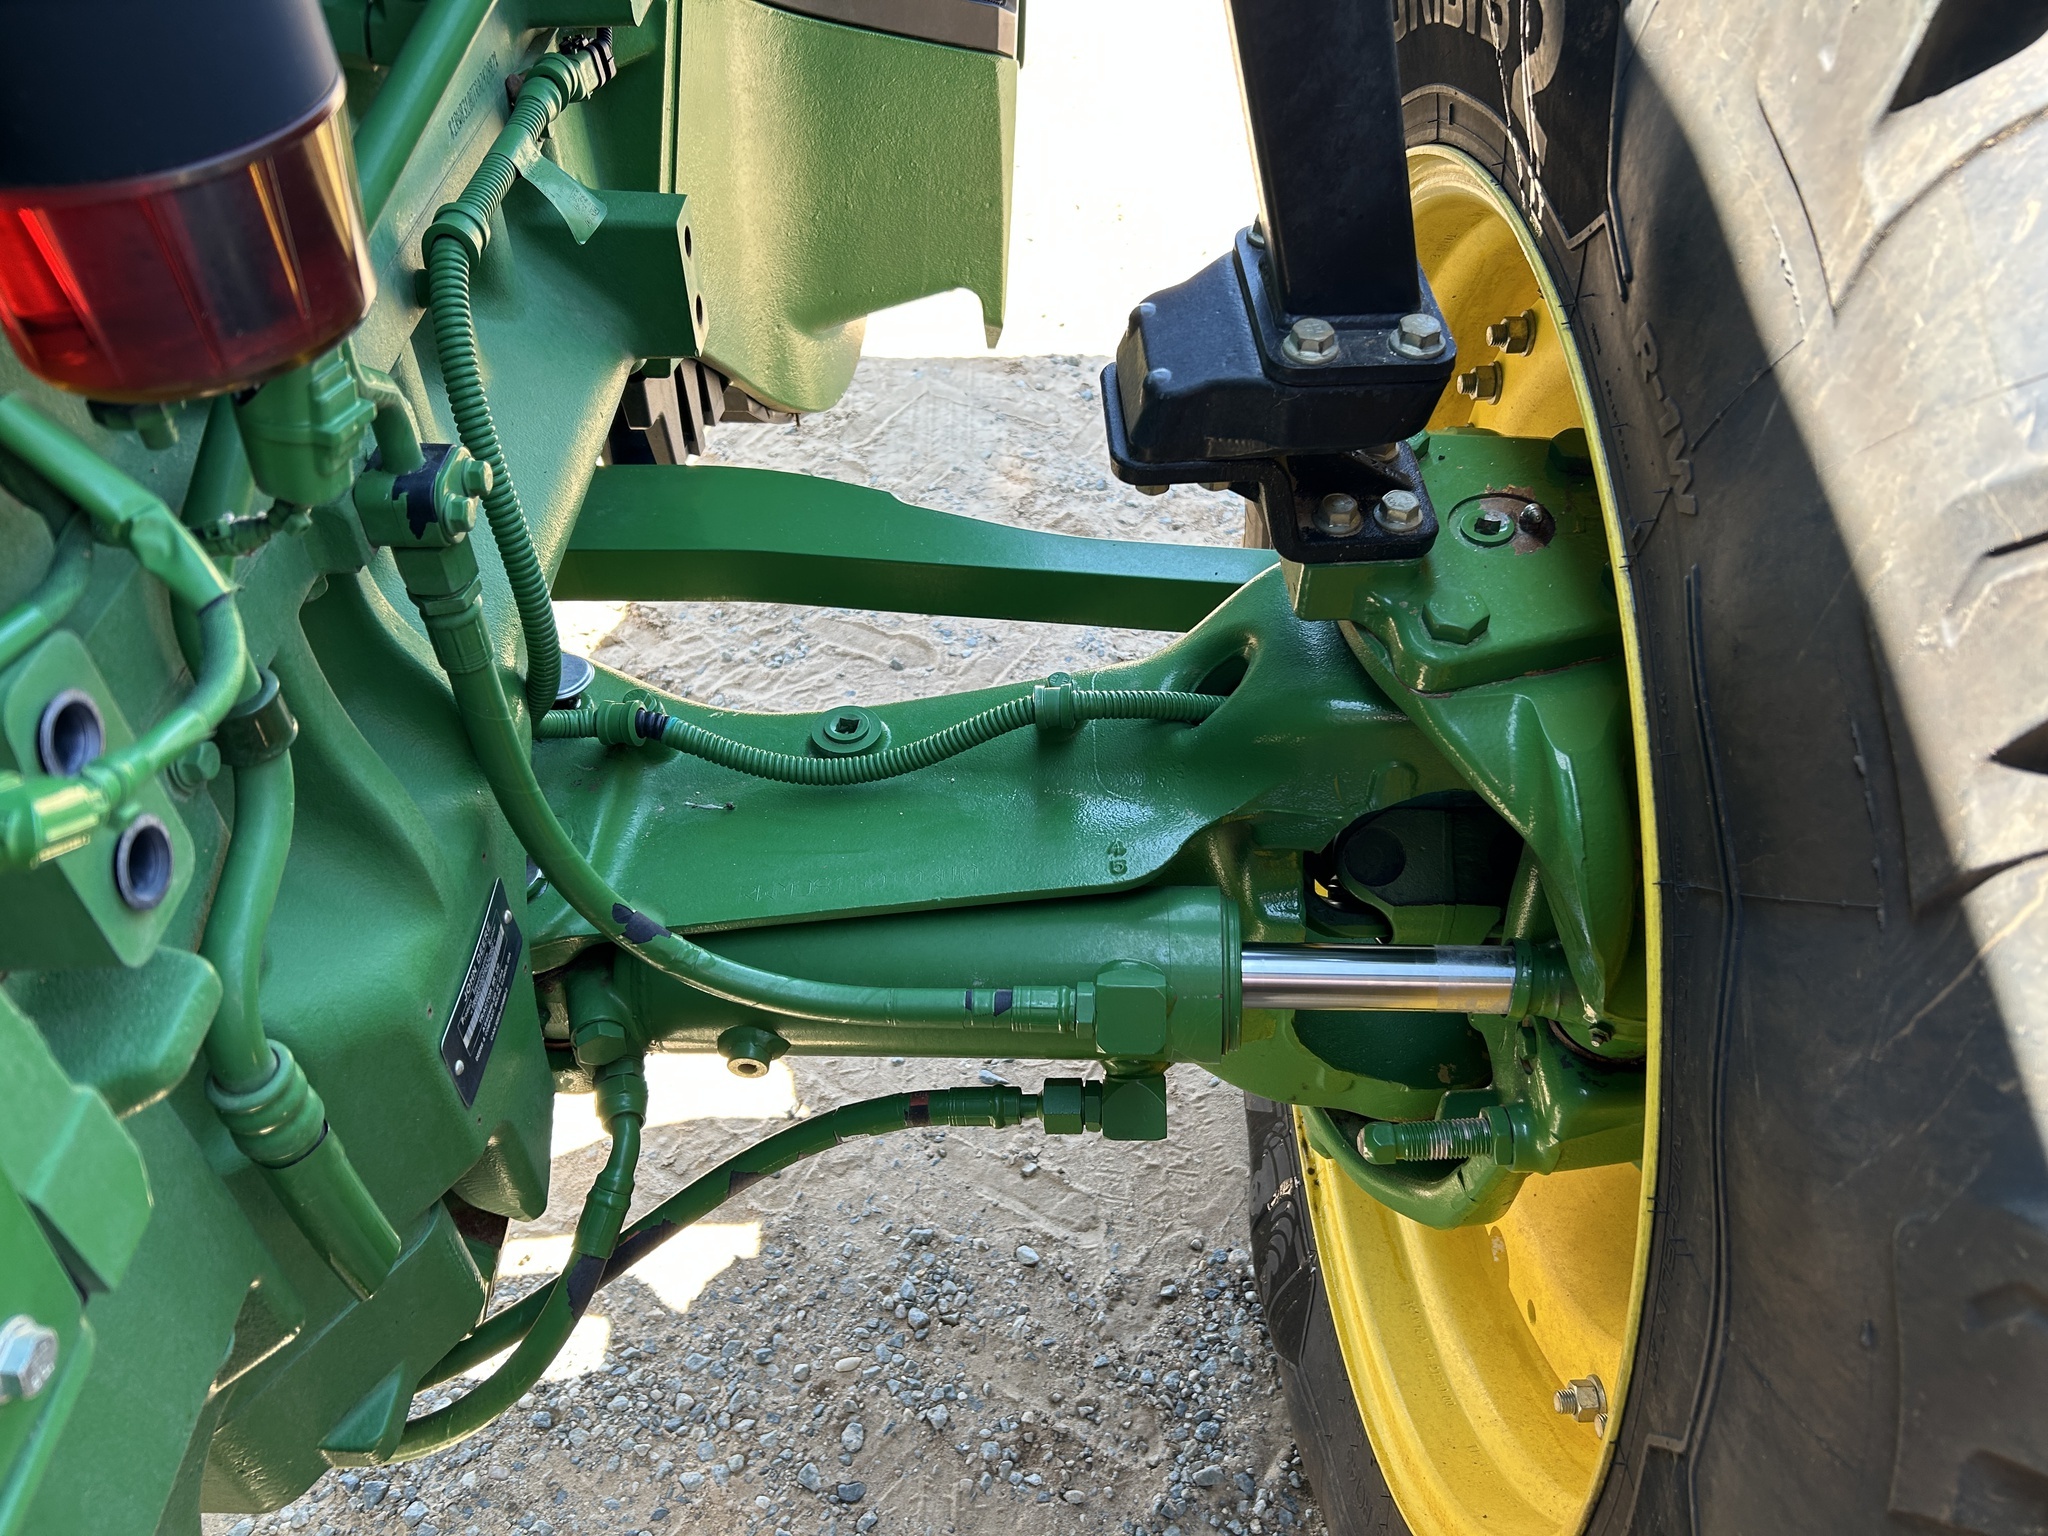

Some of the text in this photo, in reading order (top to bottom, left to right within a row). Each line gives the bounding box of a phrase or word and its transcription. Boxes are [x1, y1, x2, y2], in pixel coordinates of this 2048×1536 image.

[464, 965, 478, 1002] JOHN
[476, 920, 491, 965] DEERE
[479, 987, 493, 1023] TRACTOR
[1655, 1134, 1681, 1332] MICHELIN
